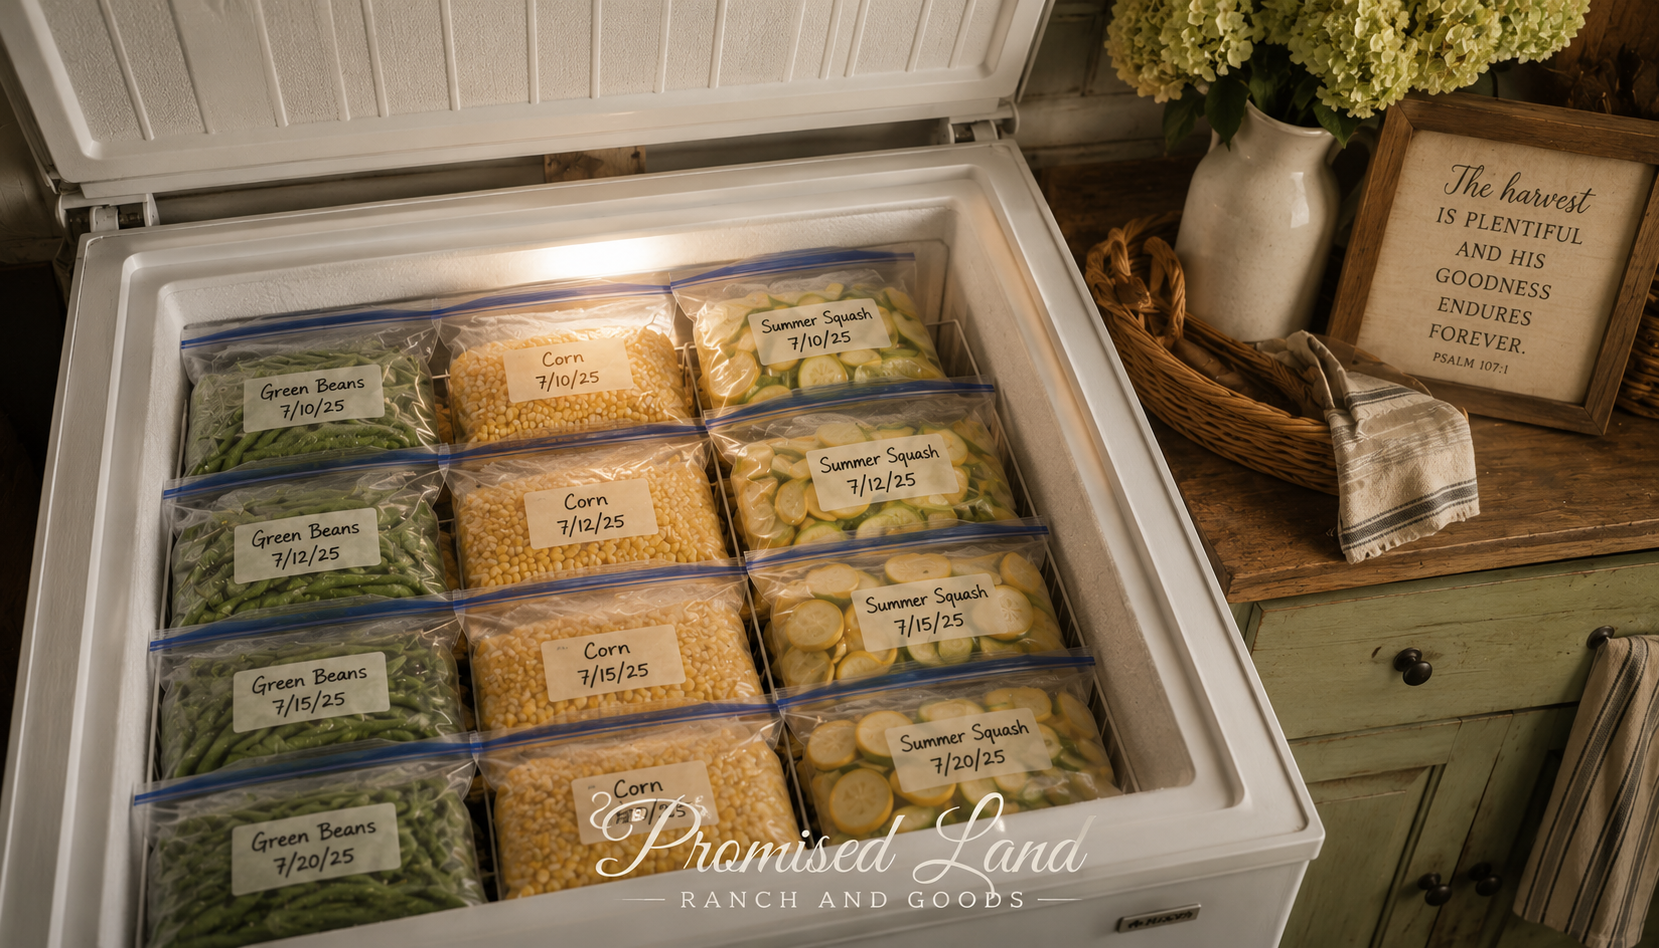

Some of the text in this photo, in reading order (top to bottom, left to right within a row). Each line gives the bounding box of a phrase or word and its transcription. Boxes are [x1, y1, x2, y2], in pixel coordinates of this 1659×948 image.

[1443, 163, 1596, 213] The harvest
[1436, 207, 1582, 244] IS PLENTIFUL
[1455, 242, 1545, 269] AND HIS
[1436, 268, 1551, 300] GOODNESS
[762, 307, 872, 333] Summer Squash
[1437, 297, 1532, 326] ENDURES
[788, 330, 851, 352] 7/10/25
[1429, 324, 1525, 354] FOREVER.
[541, 350, 585, 367] Corn
[1433, 352, 1508, 374] PSALM 107:1
[261, 378, 364, 401] Green Beans
[536, 370, 599, 392] 7/10/25
[279, 397, 345, 422] 7/10/25
[820, 444, 939, 473] Summer Squash
[847, 471, 915, 497] 7/12/25
[565, 493, 608, 510] Corn
[252, 523, 359, 549] Green Beans
[557, 512, 624, 537] 7/12/25
[272, 545, 339, 570] 7/12/25
[866, 584, 988, 613] Summer Squash
[894, 612, 963, 638] 7/15/25
[584, 642, 630, 659] Corn
[252, 668, 367, 695] Green Beans
[577, 661, 649, 689] 7/15/25
[272, 690, 345, 717] 7/15/25
[900, 719, 1029, 752] Summer Squash
[930, 748, 1005, 776] 7/20/25
[614, 779, 663, 798] Corn
[252, 822, 376, 853] Green Beans
[273, 846, 354, 878] 7/20/25
